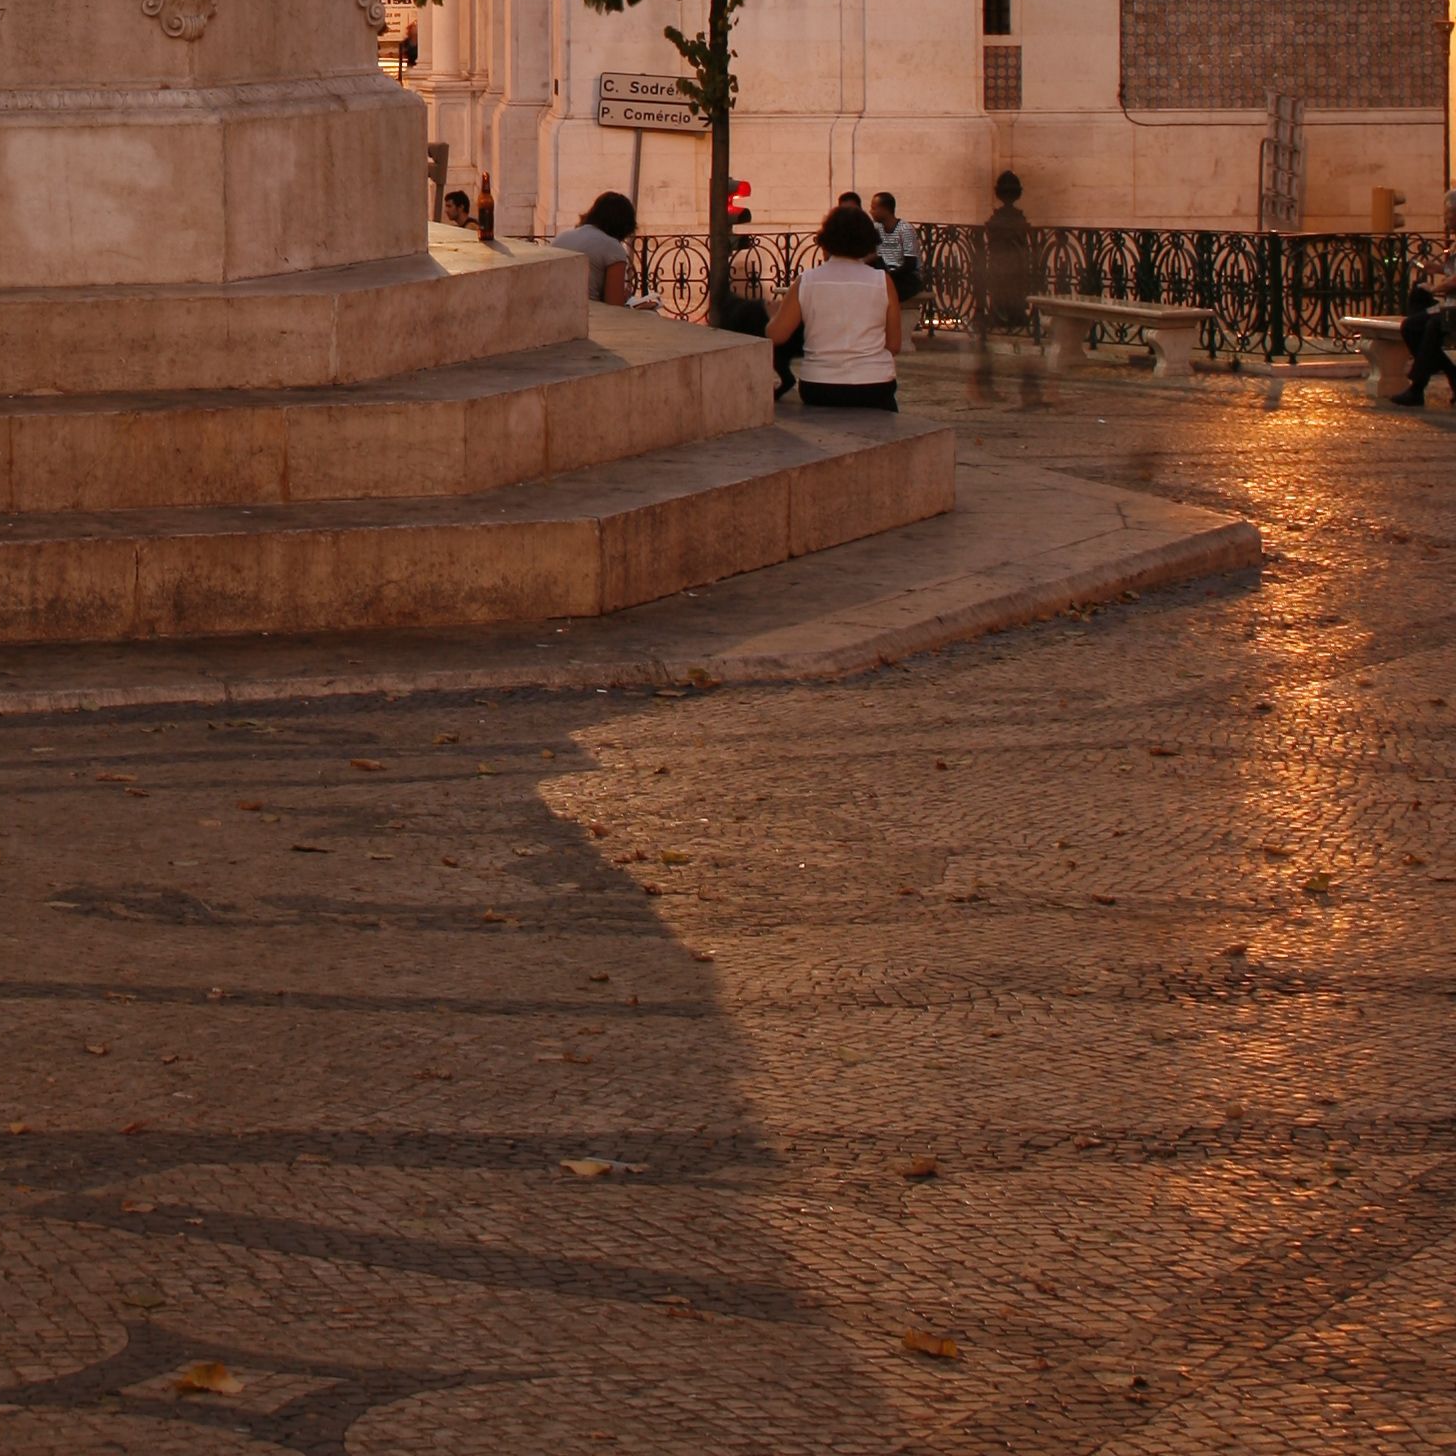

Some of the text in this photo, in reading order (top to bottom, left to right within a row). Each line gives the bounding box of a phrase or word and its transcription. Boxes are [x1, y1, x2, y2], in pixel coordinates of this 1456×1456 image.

[604, 79, 675, 96] C. Sodré
[601, 107, 691, 124] P. Comércio
